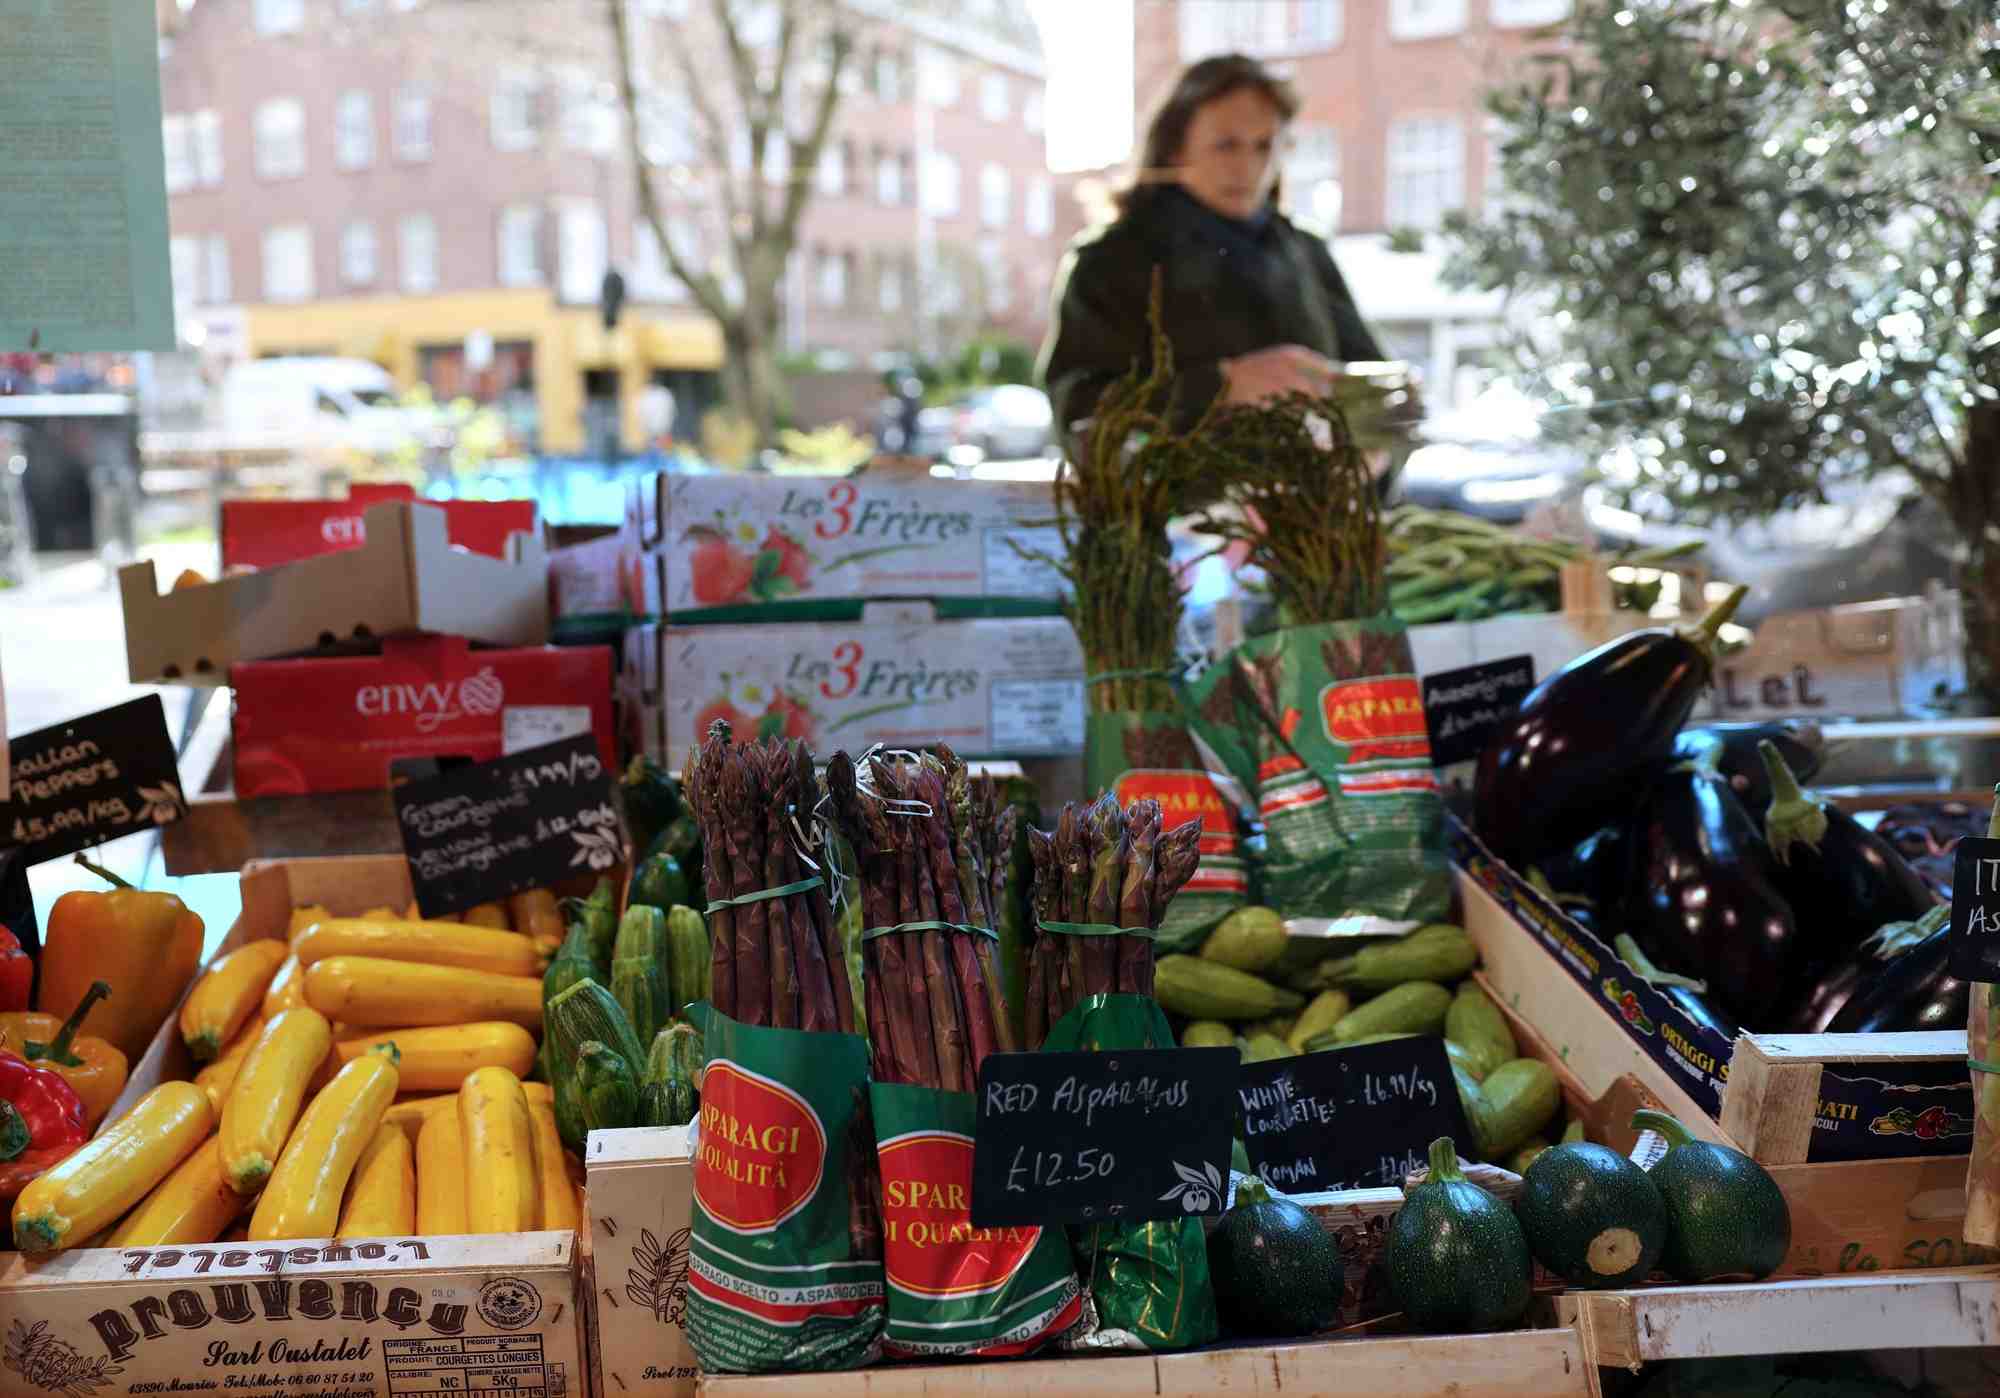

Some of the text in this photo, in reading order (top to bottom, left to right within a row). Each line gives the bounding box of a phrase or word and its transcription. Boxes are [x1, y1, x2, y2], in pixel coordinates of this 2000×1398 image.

[814, 479, 859, 540] 3
[855, 498, 972, 543] Frères
[321, 516, 367, 544] en
[819, 639, 864, 700] 3
[862, 658, 979, 701] Frères
[355, 682, 462, 732] envy
[1332, 695, 1422, 721] ASPARA
[1660, 1024, 1716, 1074] ORTAGGI
[986, 1080, 1038, 1117] RED
[705, 1144, 787, 1190] QUALITÀ
[1005, 1144, 1116, 1192] £12.50
[886, 1179, 972, 1211] SPAR
[732, 1276, 779, 1303] SCELTO
[268, 1336, 375, 1365] Oustalet
[409, 1344, 458, 1354] FRANCE
[435, 1353, 496, 1366] COURGETTES
[496, 1351, 539, 1364] LONGUES
[287, 1375, 302, 1386] 06
[324, 1373, 339, 1385] 87
[356, 1371, 375, 1383] 20
[440, 1376, 459, 1388] NC
[491, 1375, 518, 1387] 5Kg
